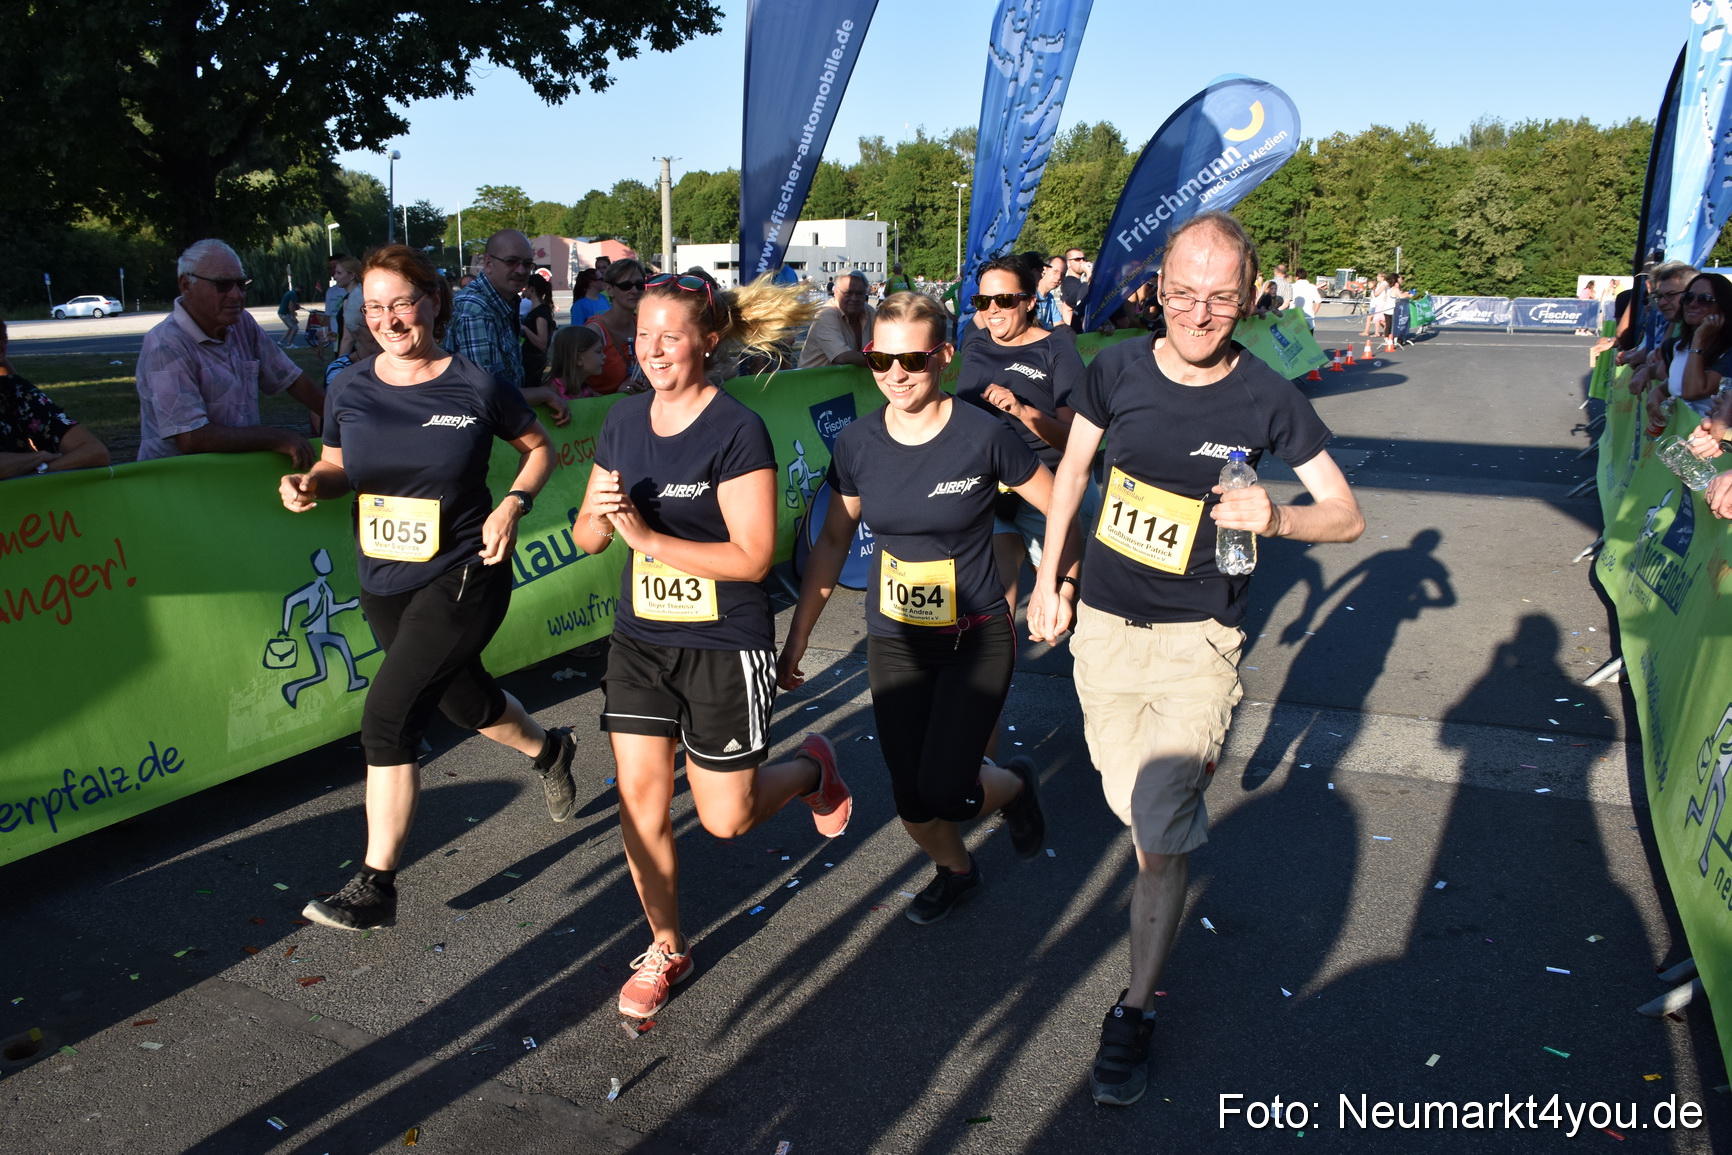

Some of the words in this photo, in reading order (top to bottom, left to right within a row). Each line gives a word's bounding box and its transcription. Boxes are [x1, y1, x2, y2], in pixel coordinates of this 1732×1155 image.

[756, 19, 854, 273] www.fischer-automobile.de
[1198, 177, 1229, 203] Druck
[1228, 158, 1250, 178] und
[1248, 130, 1288, 162] Medien
[1116, 145, 1242, 253] Frischmann
[1538, 310, 1582, 320] Fischer
[824, 416, 852, 434] Fischer
[370, 518, 427, 545] 1055
[1113, 501, 1179, 549] 1114
[642, 575, 702, 602] 1043
[887, 579, 944, 608] 1054
